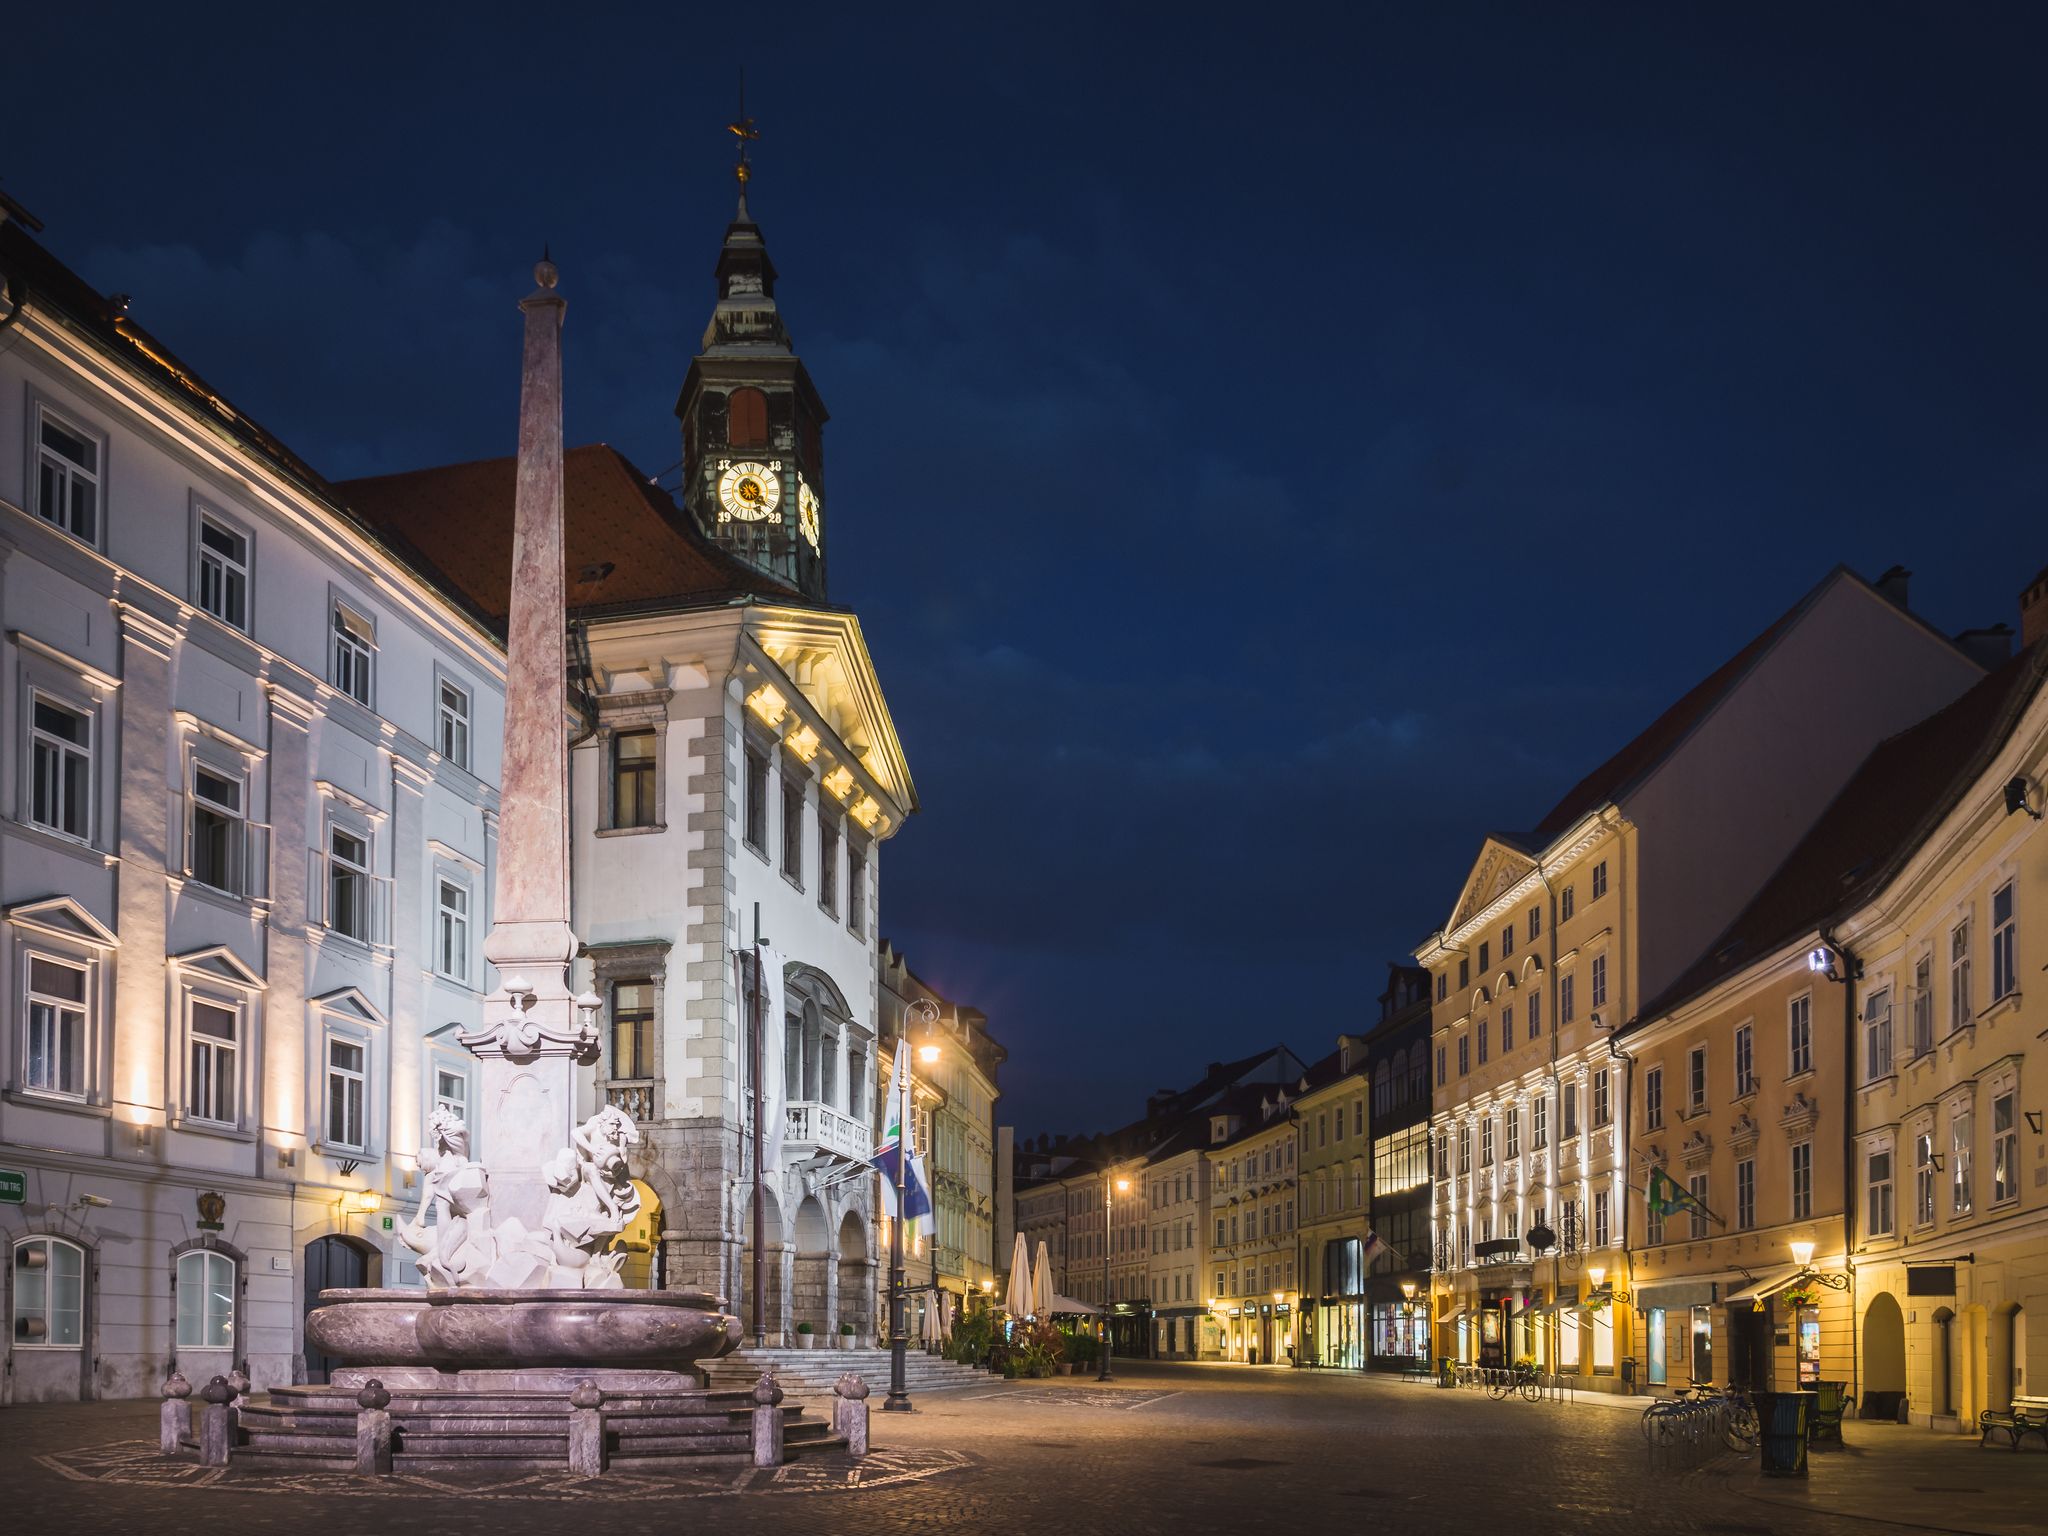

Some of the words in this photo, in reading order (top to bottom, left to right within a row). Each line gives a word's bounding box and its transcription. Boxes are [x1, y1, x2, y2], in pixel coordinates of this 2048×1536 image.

[769, 461, 782, 472] 18
[718, 512, 731, 523] 19
[768, 512, 782, 524] 28
